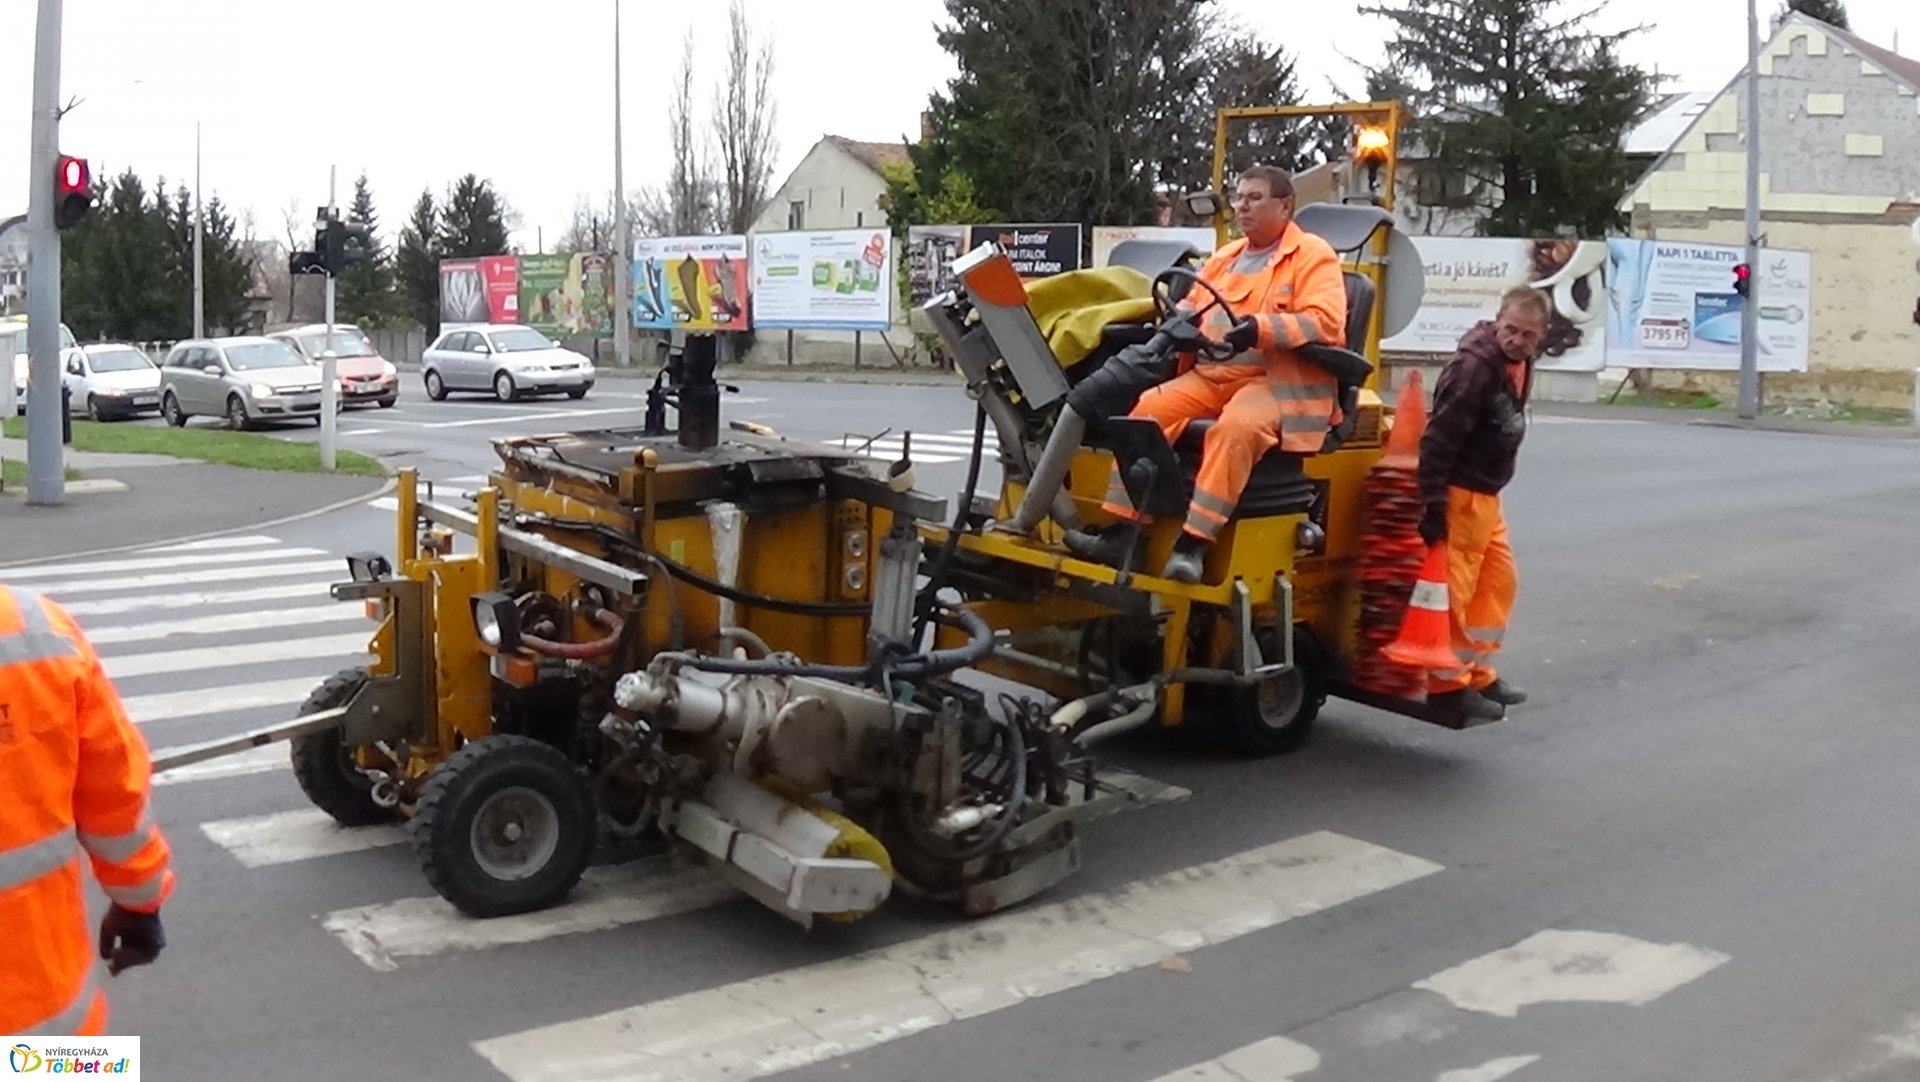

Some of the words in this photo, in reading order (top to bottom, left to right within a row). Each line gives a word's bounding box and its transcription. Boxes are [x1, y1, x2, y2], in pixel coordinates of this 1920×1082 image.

[1018, 233, 1049, 245] center
[1019, 249, 1047, 260] ITALOK
[1656, 247, 1681, 259] NAPI
[1683, 249, 1688, 259] 1
[1690, 250, 1739, 261] TABLETTA
[1452, 261, 1465, 281] jó
[1467, 261, 1509, 278] kávét?
[1643, 328, 1672, 341] 3795
[1675, 329, 1686, 341] Ft
